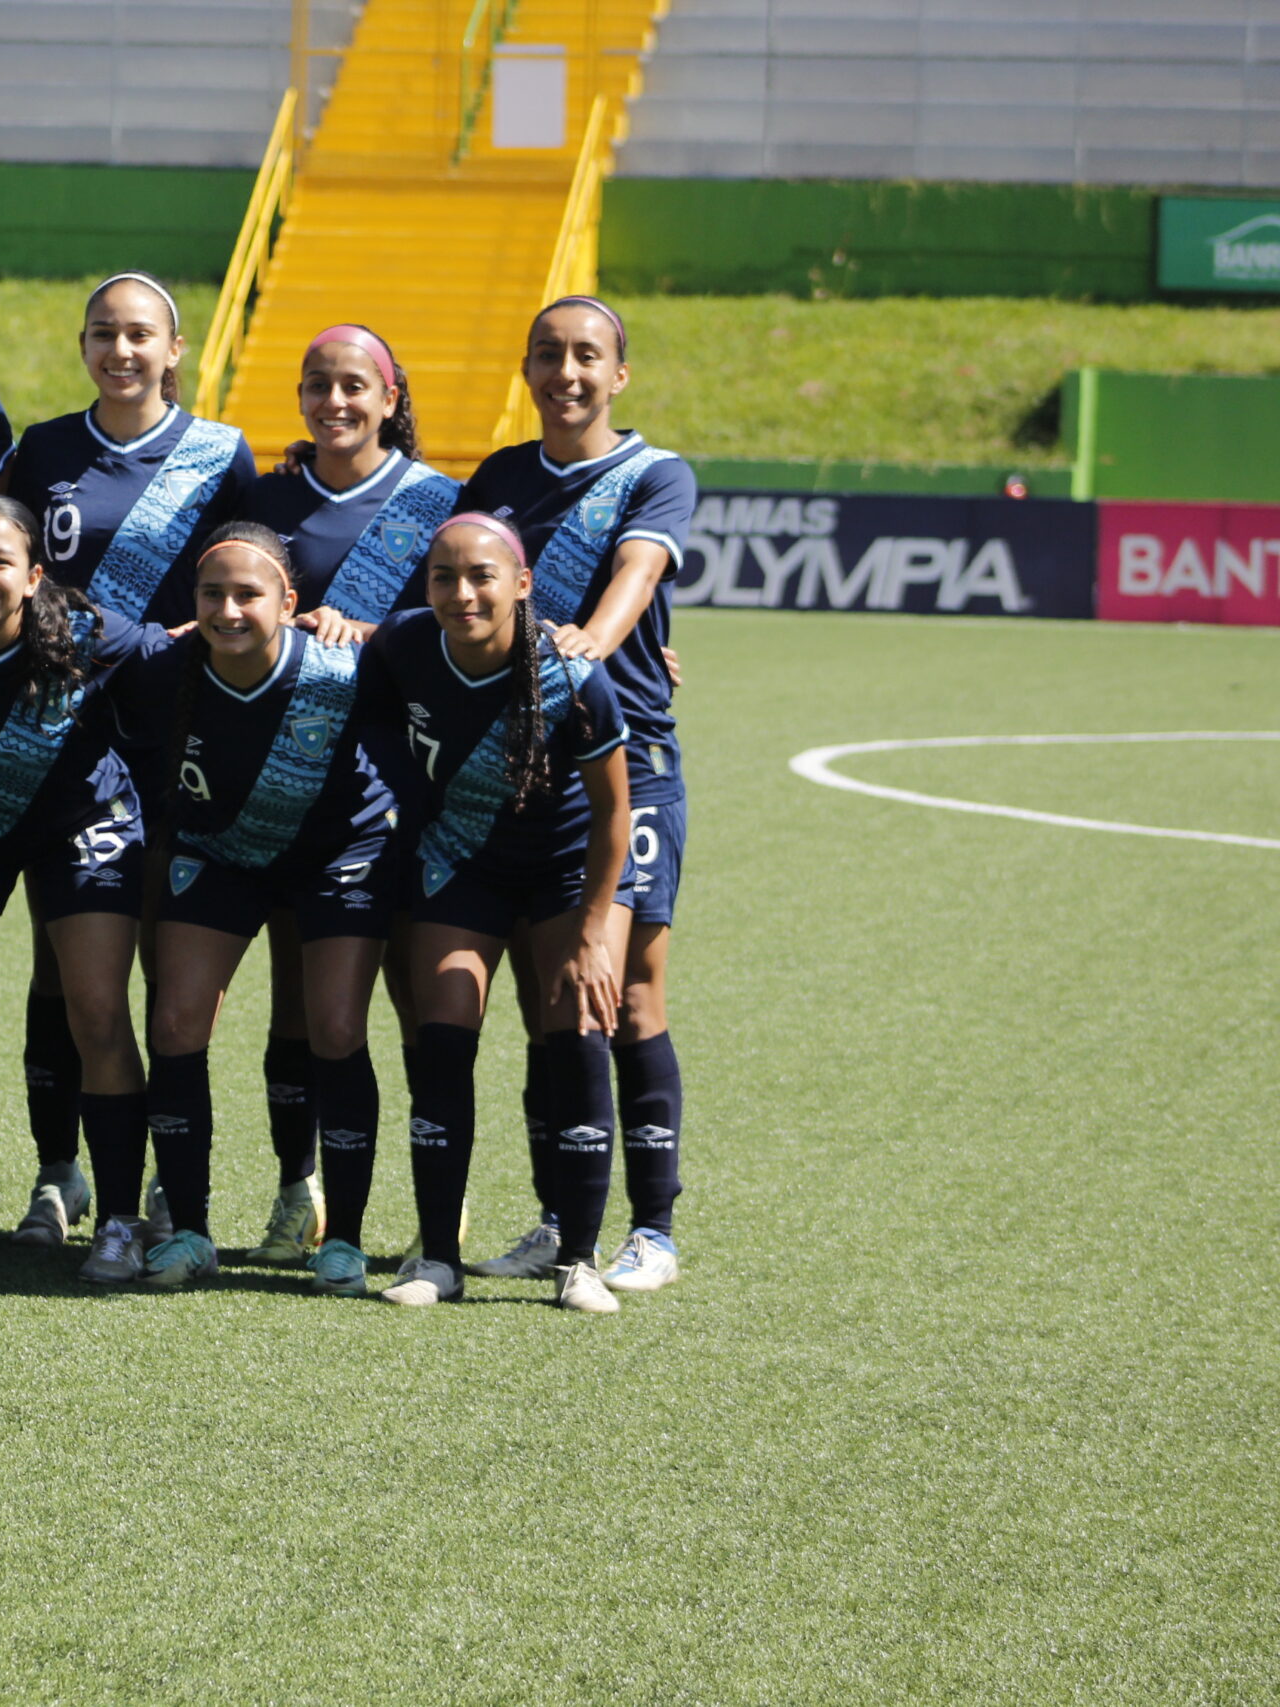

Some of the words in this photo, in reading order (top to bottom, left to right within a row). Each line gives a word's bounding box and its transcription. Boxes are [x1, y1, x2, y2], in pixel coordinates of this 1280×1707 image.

[690, 496, 840, 536] AMAS
[672, 532, 1023, 612] OLYMPIA
[74, 820, 126, 864] 15
